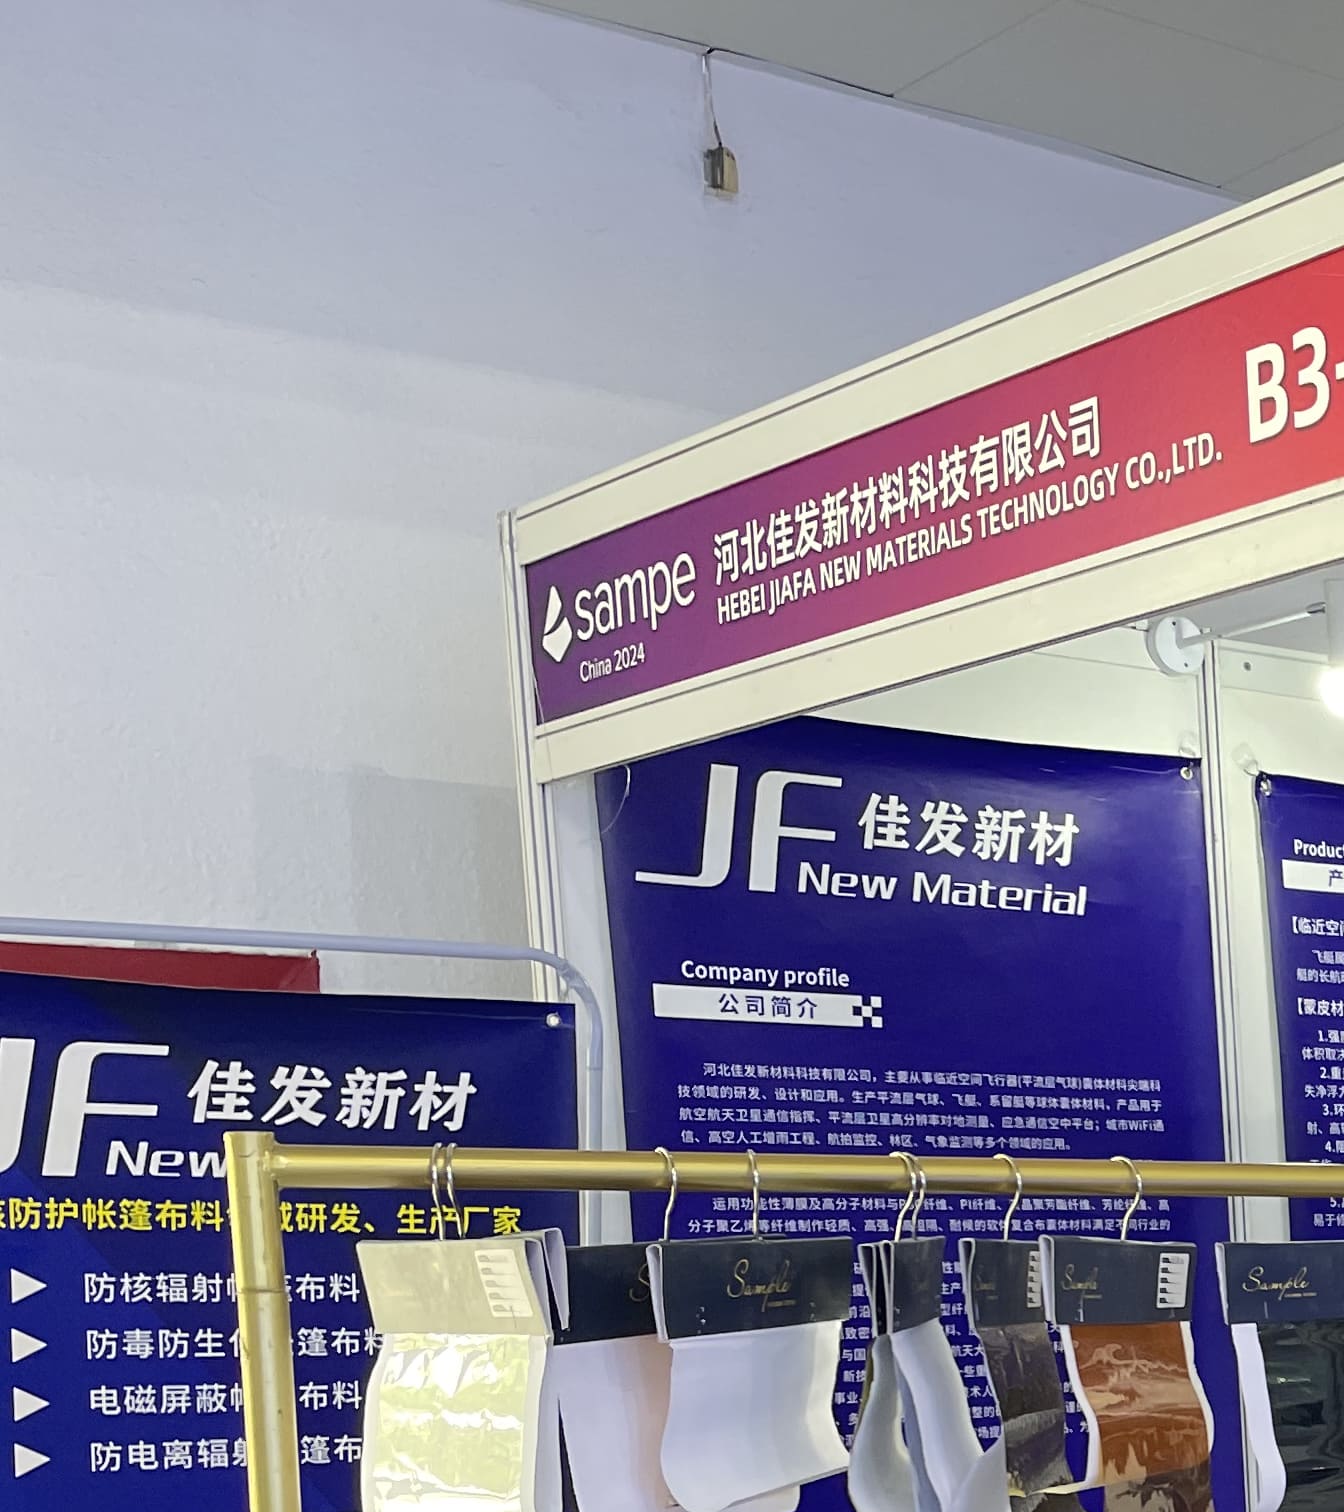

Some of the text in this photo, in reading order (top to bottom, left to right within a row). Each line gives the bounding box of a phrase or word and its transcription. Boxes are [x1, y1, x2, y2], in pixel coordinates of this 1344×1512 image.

[713, 396, 1101, 586] 河北佳发新材料科技有限公司
[717, 430, 1224, 625] HEBEI JIAFA NEW MATERIALS TECHNOLOGY CO.,LTD.
[574, 552, 696, 641] sampe
[580, 642, 645, 682] China 2024
[634, 763, 843, 893] JF
[858, 792, 1080, 868] 佳发新材
[797, 860, 1087, 916] New Material
[681, 960, 850, 989] Company profile
[718, 992, 819, 1019] 公司简介
[187, 1059, 479, 1132] 佳发新材
[84, 1272, 361, 1304] 防核辐射布料
[726, 1258, 793, 1313] Sample
[1241, 1265, 1312, 1300] Sample
[90, 1380, 362, 1416] 电磁屏蔽布料
